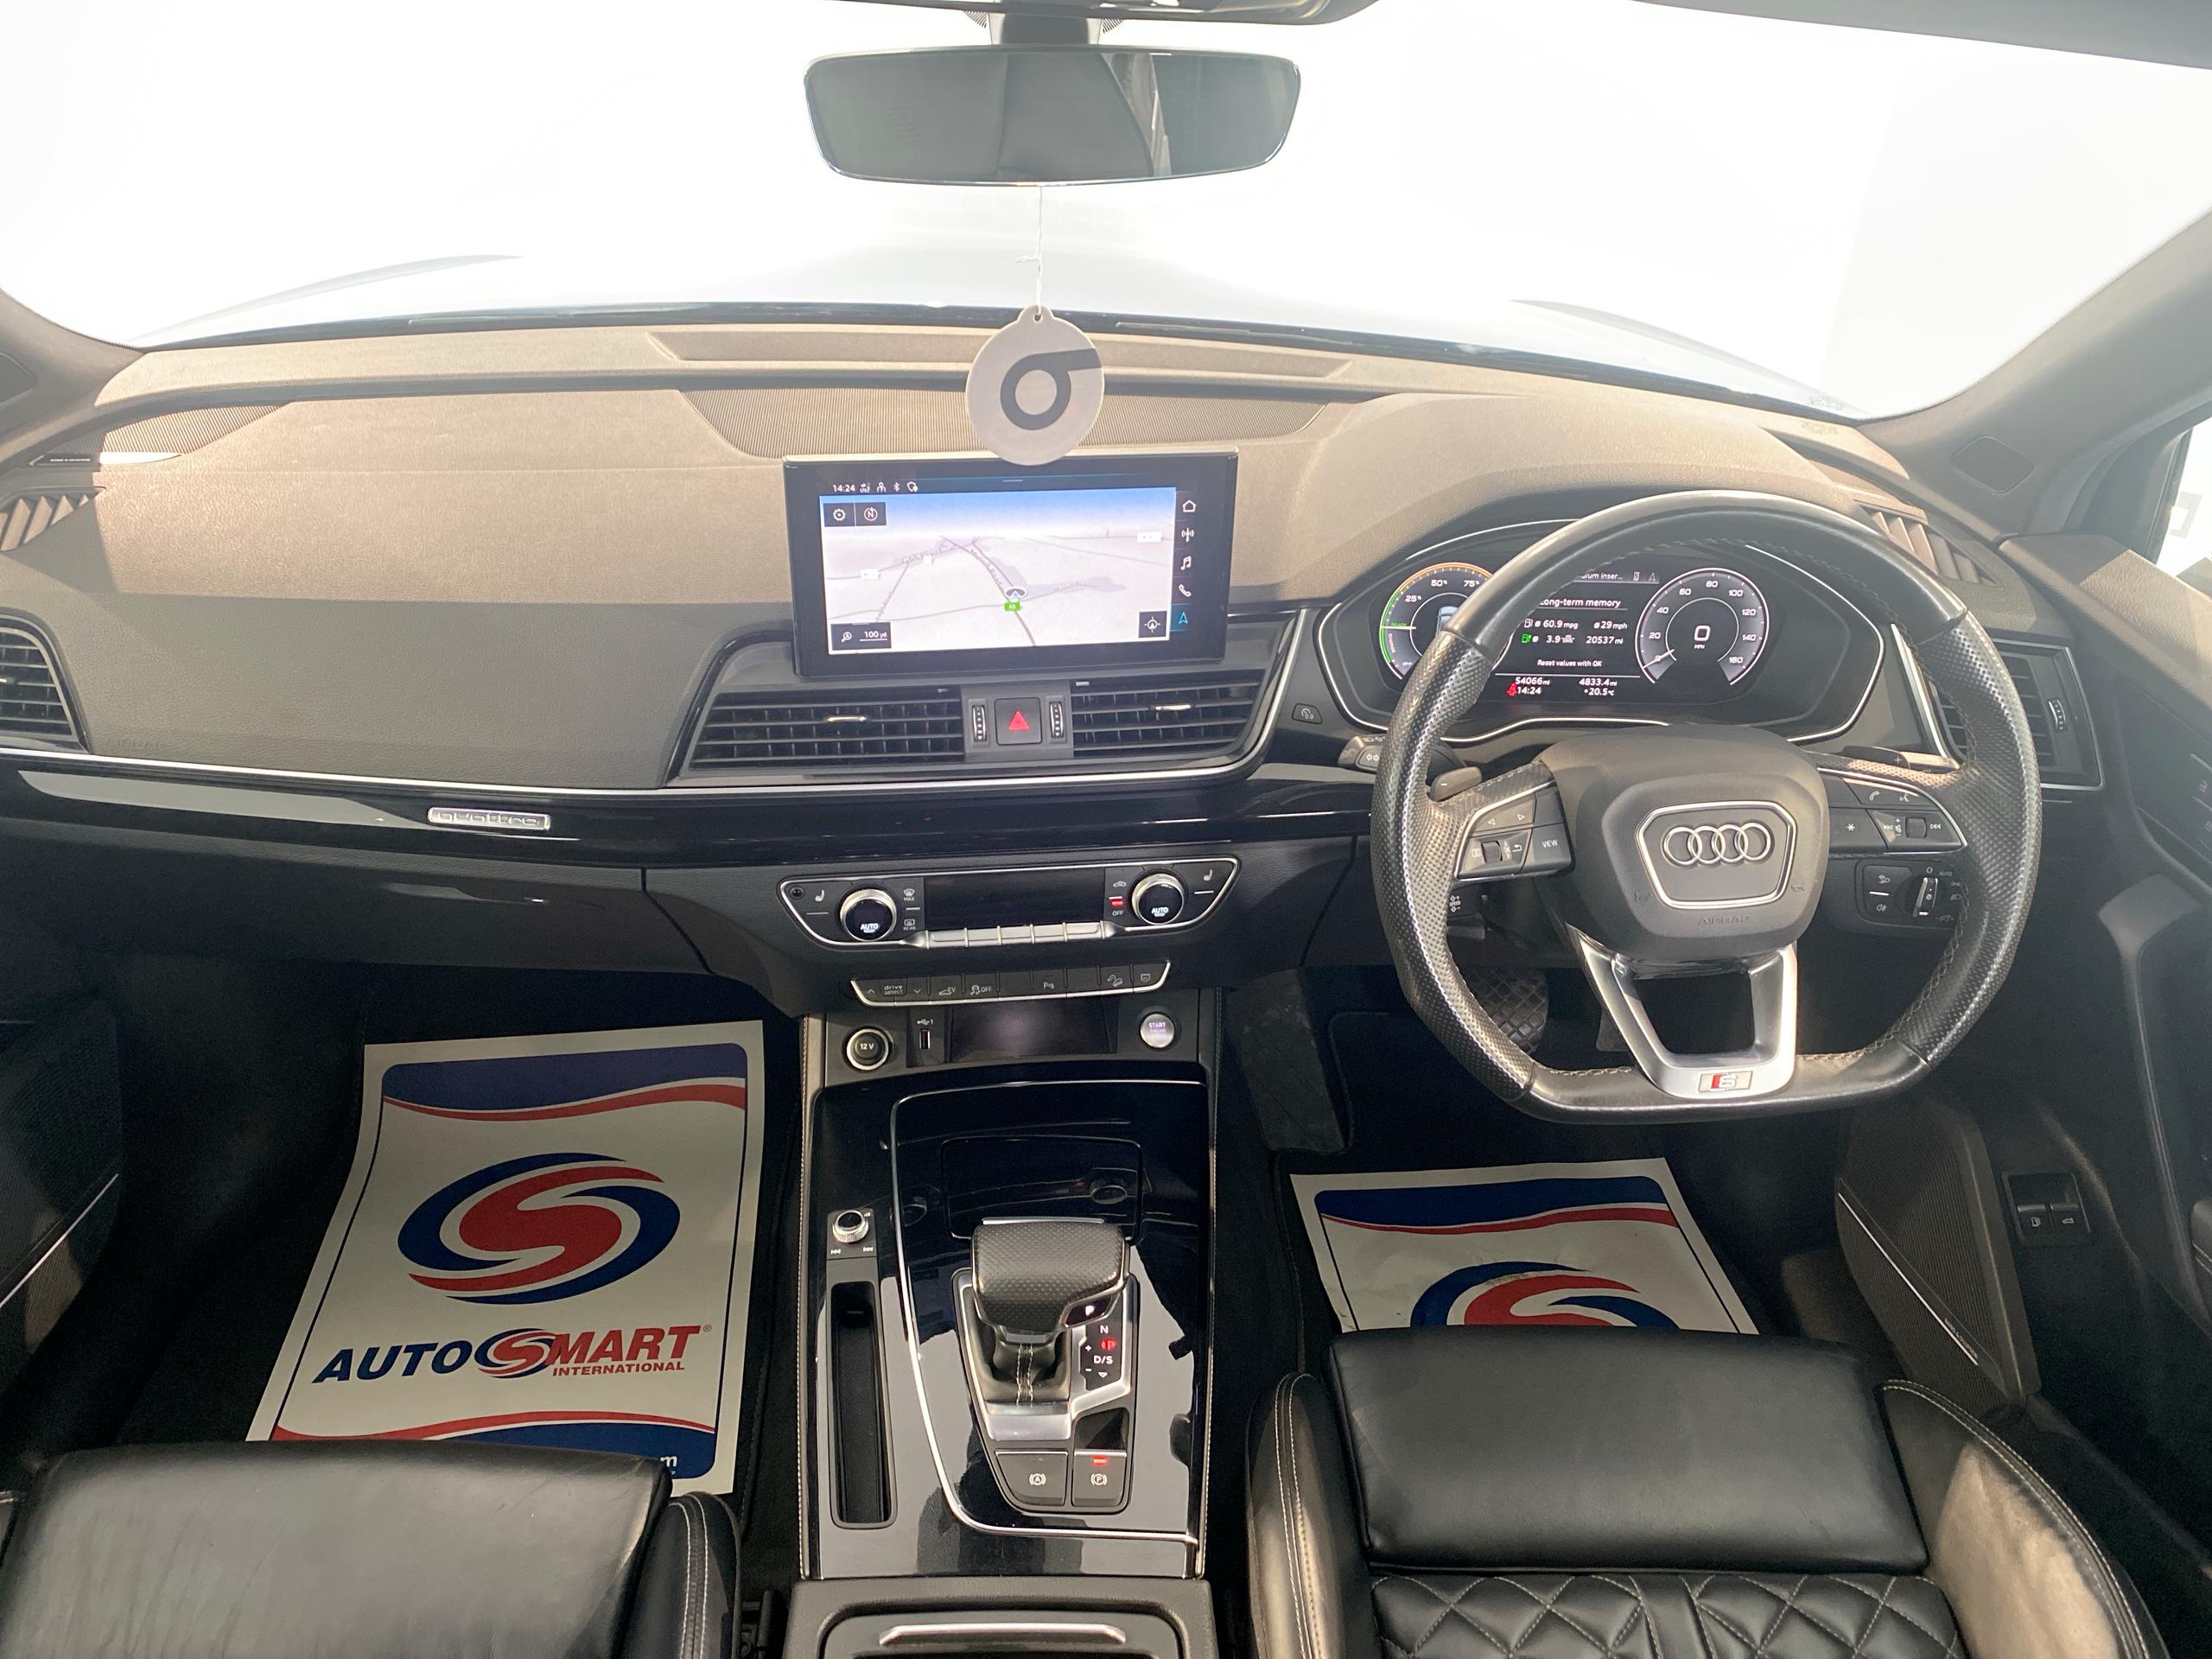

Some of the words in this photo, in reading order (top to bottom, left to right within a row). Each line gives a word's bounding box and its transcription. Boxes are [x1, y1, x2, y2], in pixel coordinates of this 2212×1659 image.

[832, 484, 856, 493] 14:24
[1585, 600, 1622, 609] memory
[1542, 620, 1563, 628] 60.9
[1694, 625, 1711, 641] 0
[1586, 636, 1615, 645] 20537
[1515, 677, 1543, 685] 54066
[1517, 686, 1541, 695] 14:24
[438, 812, 538, 824] quattro
[1541, 840, 1558, 849] VIEW
[1100, 1325, 1109, 1334] N
[1093, 1355, 1114, 1364] D/S
[552, 1361, 685, 1376] INTERNATIONAL
